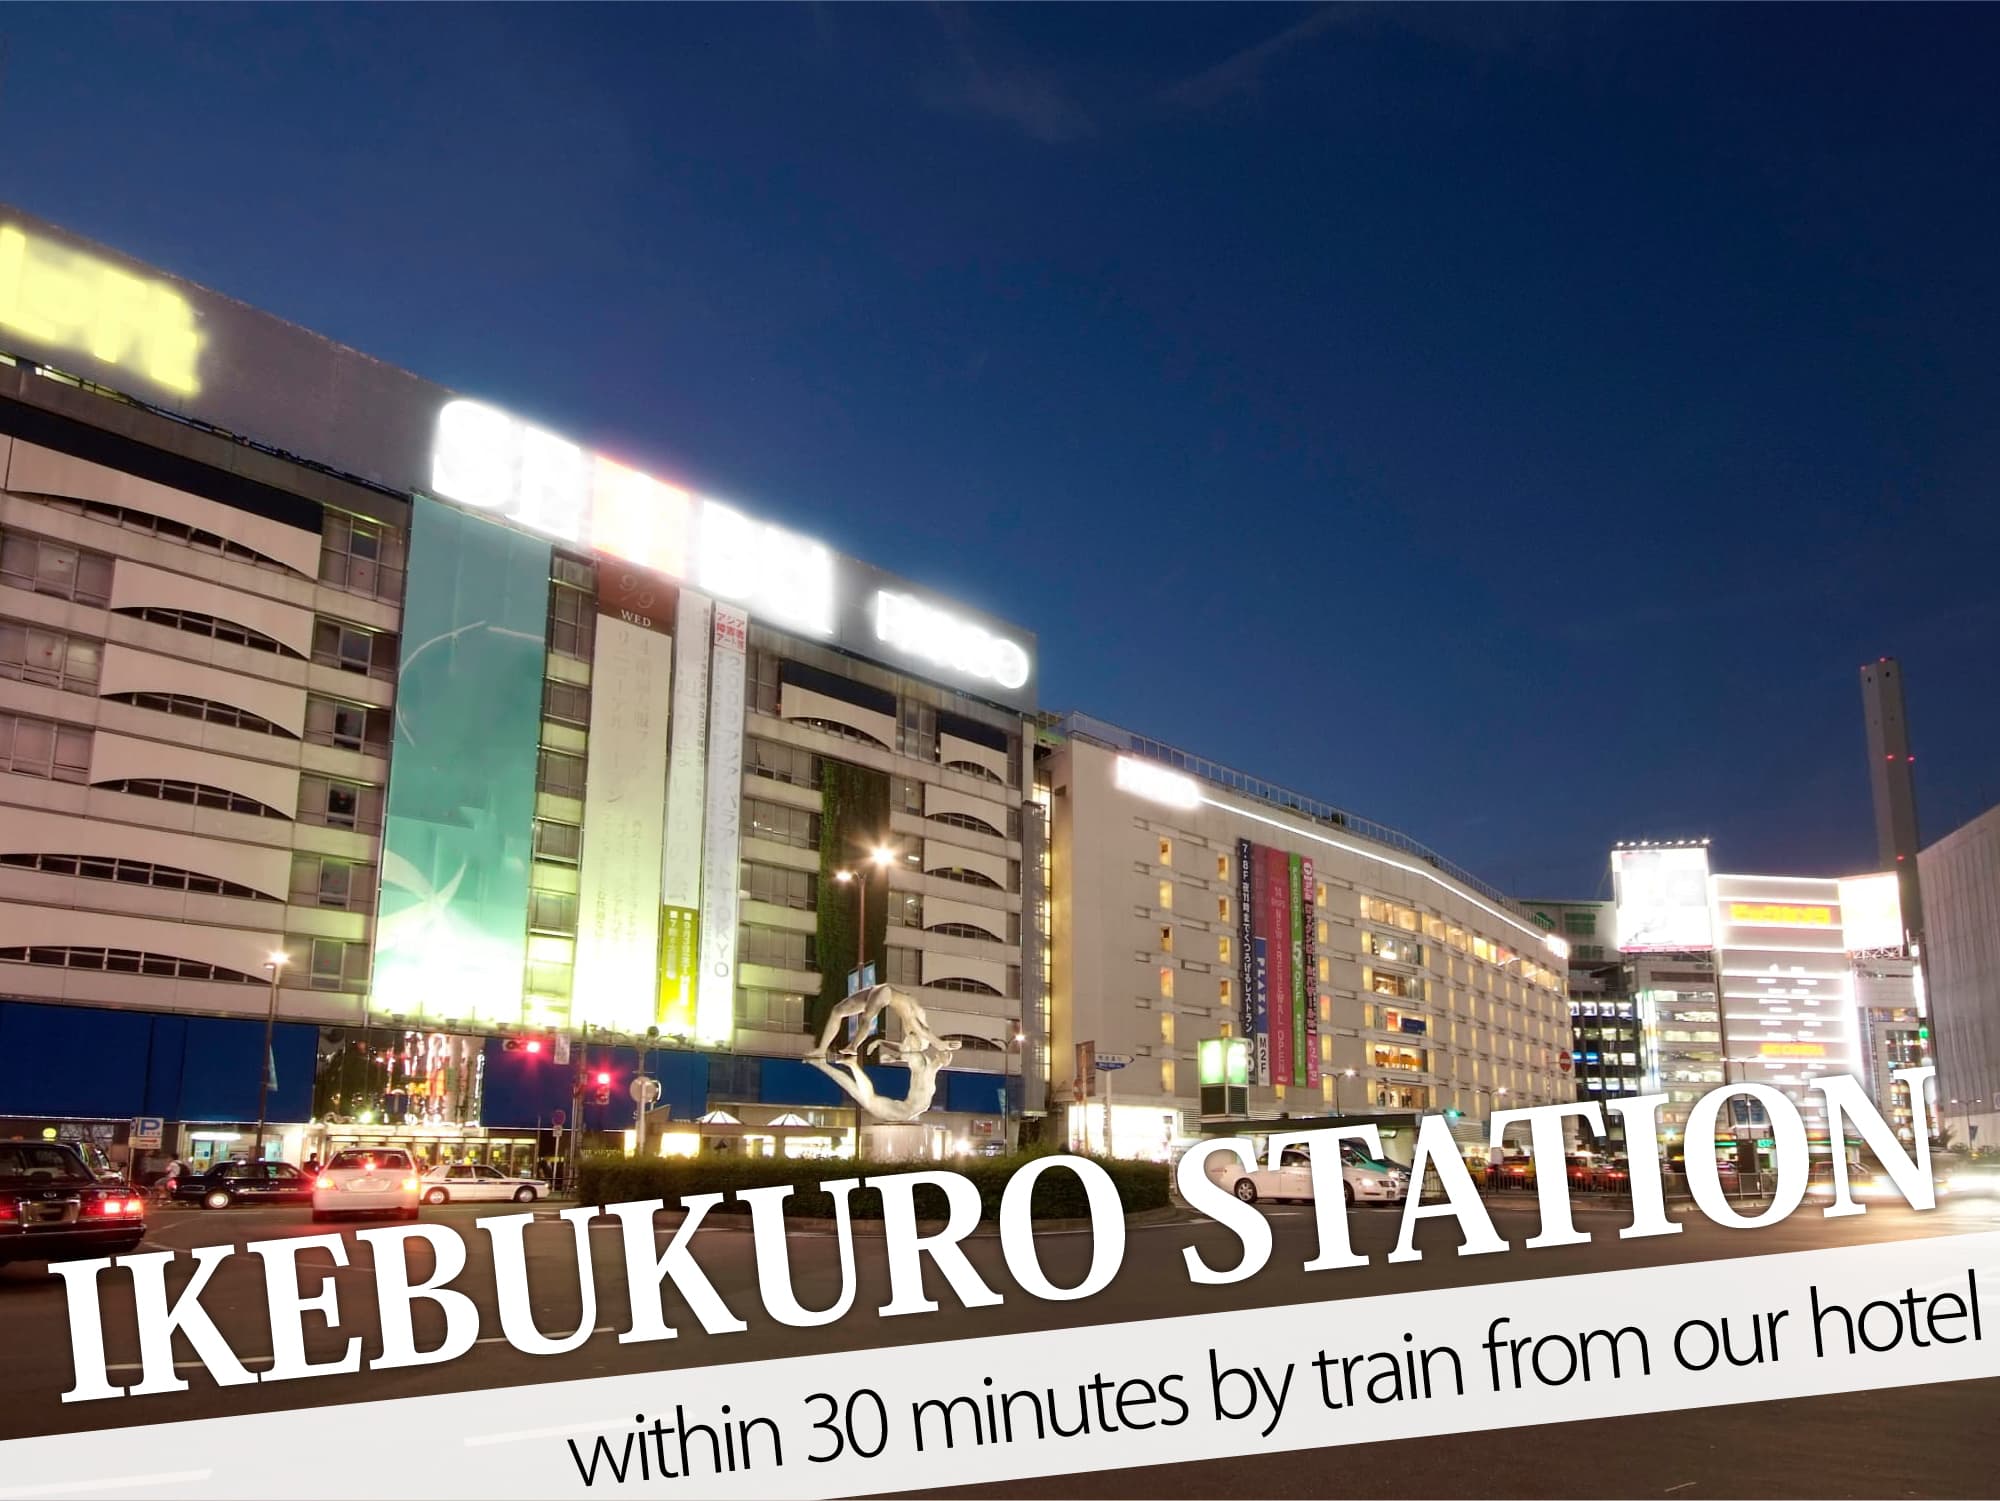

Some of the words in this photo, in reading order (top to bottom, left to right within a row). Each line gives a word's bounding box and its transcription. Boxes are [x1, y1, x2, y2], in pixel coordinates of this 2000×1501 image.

[620, 608, 652, 628] WED
[1259, 1037, 1267, 1073] M2F
[140, 1119, 160, 1135] P
